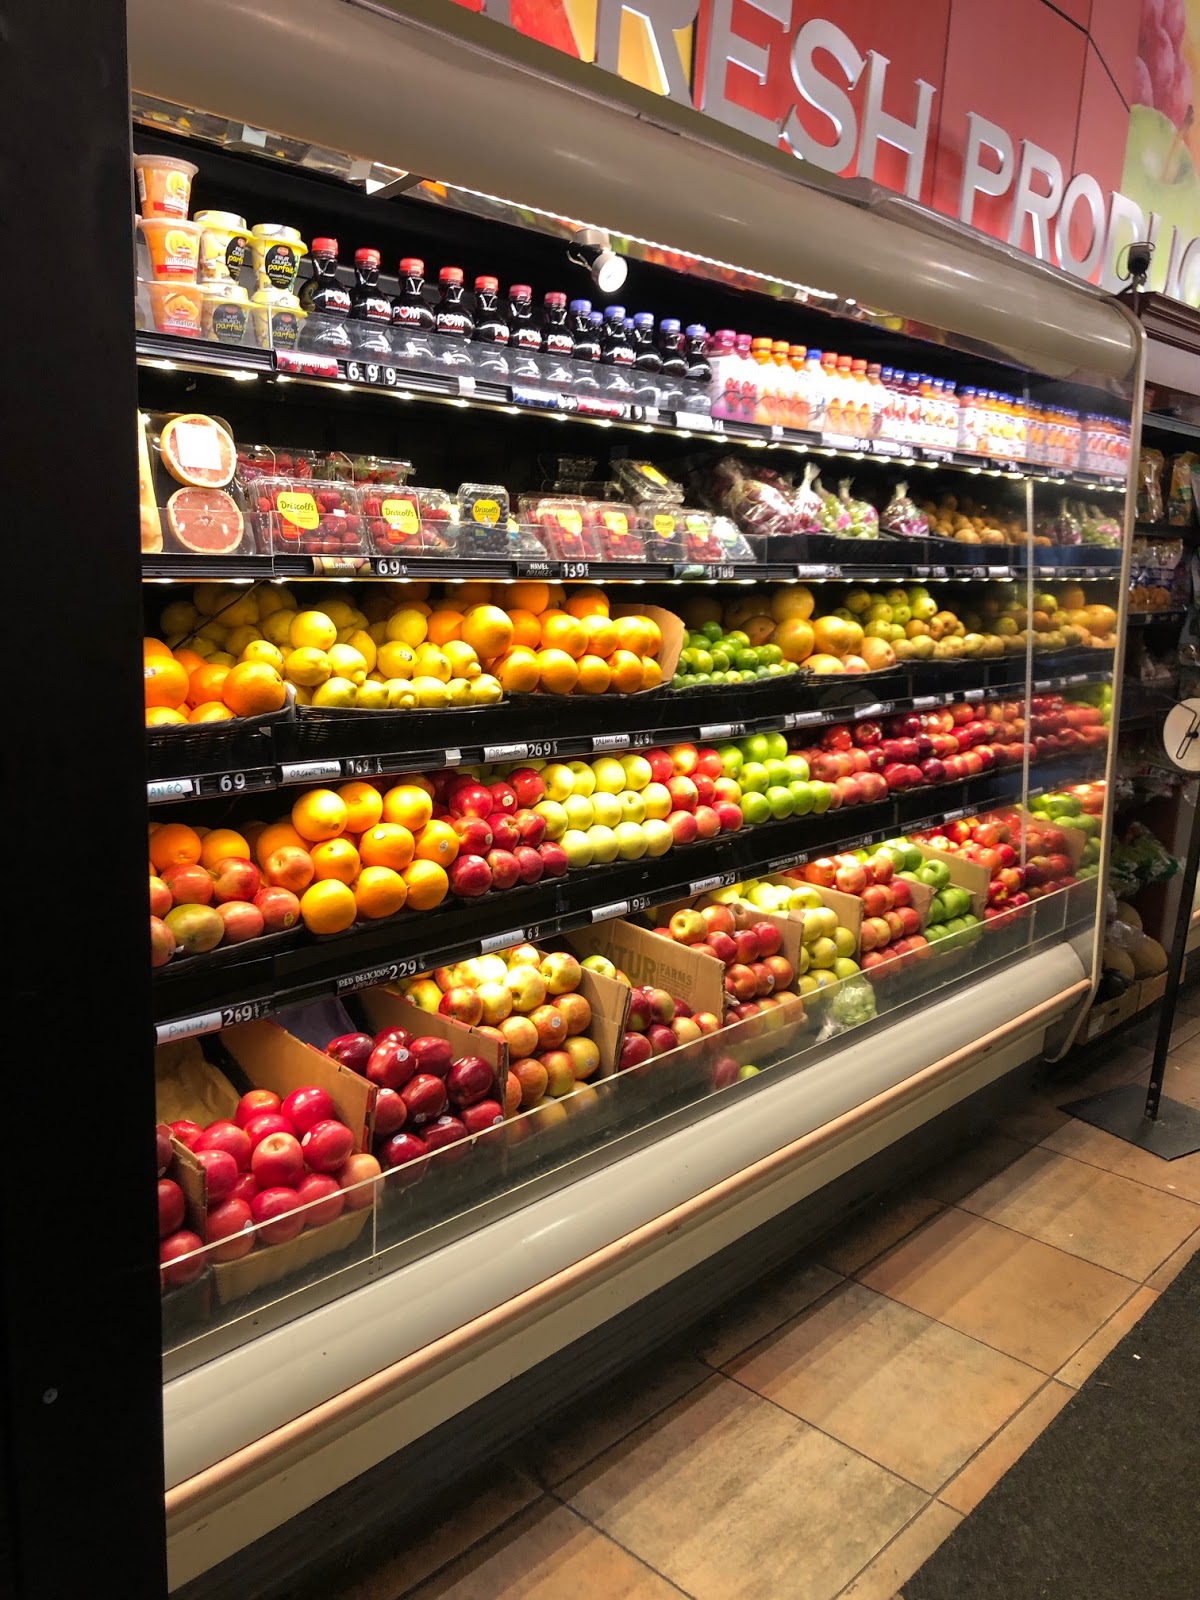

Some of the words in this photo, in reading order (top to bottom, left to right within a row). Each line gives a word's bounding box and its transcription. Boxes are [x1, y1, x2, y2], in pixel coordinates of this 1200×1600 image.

[481, 0, 935, 204] RESH
[392, 306, 421, 320] POM
[436, 313, 465, 328] POM
[279, 500, 315, 512] Driscoll's
[384, 507, 414, 518] Driscoll's
[474, 504, 499, 514] Driscoll's
[378, 558, 400, 575] 69
[563, 562, 585, 578] 139
[528, 742, 552, 757] 269
[220, 772, 246, 792] 69
[338, 977, 354, 988] RED
[355, 967, 391, 983] DELICIOUS
[389, 959, 417, 980] 229
[659, 962, 693, 987] FARMS
[223, 1004, 253, 1027] 269
